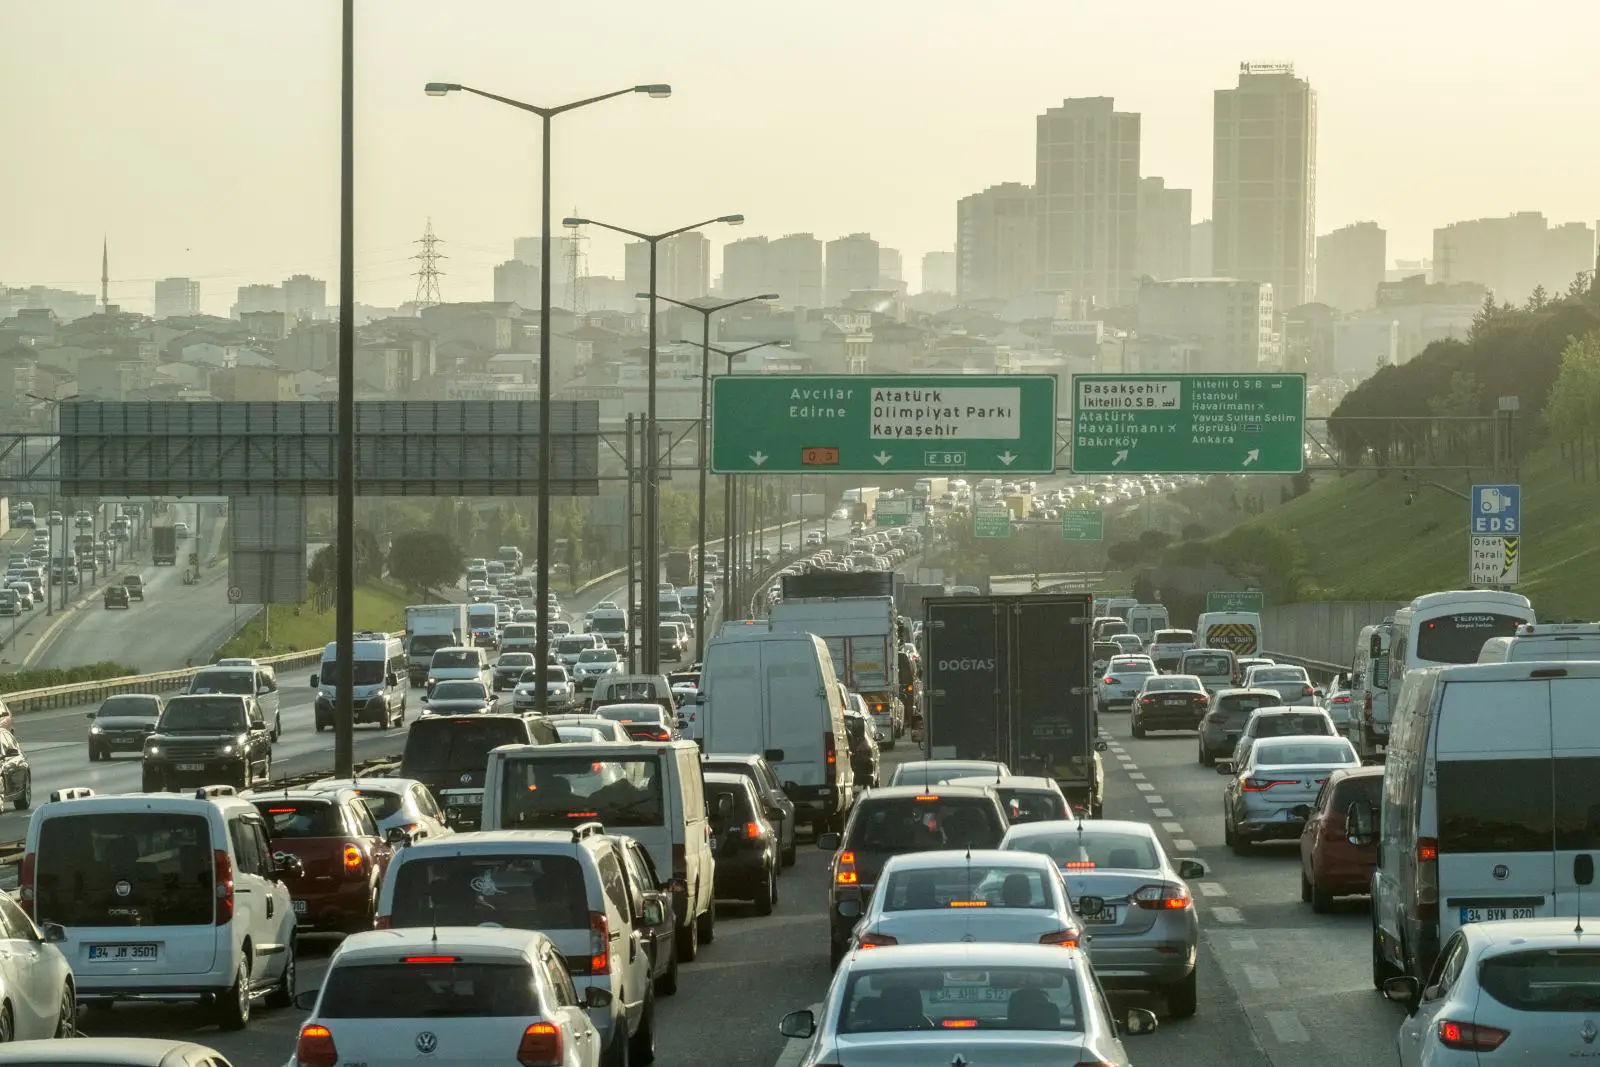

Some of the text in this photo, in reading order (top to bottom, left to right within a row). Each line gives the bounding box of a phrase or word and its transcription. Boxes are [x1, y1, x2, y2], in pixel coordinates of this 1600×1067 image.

[790, 388, 854, 400] Avcılar
[1084, 384, 1168, 395] Başakşehir
[875, 390, 942, 402] Atatürk
[1192, 390, 1238, 400] İstanbul
[1084, 395, 1121, 407] İkitelli
[1192, 402, 1255, 411] Havalimanı
[790, 406, 847, 418] Edirne
[873, 406, 1011, 420] Olimpiyat Parkı
[1079, 411, 1135, 421] Atatürk
[1192, 413, 1296, 422] Yavuz Sultan Selim
[873, 424, 959, 438] Kayaşehir
[1078, 423, 1163, 433] Havalimanı
[1191, 424, 1237, 433] Köprüsü
[1078, 436, 1138, 448] Bakırköy
[1192, 435, 1234, 444] Ankara
[944, 454, 962, 464] 80
[1476, 517, 1515, 531] EDS
[1473, 538, 1502, 546] Ofset
[1474, 549, 1502, 559] Taralı
[1474, 562, 1498, 571] Alan
[1473, 573, 1498, 583] İhlali
[1468, 909, 1481, 920] 34
[96, 947, 108, 958] 34
[131, 946, 154, 958] 3501
